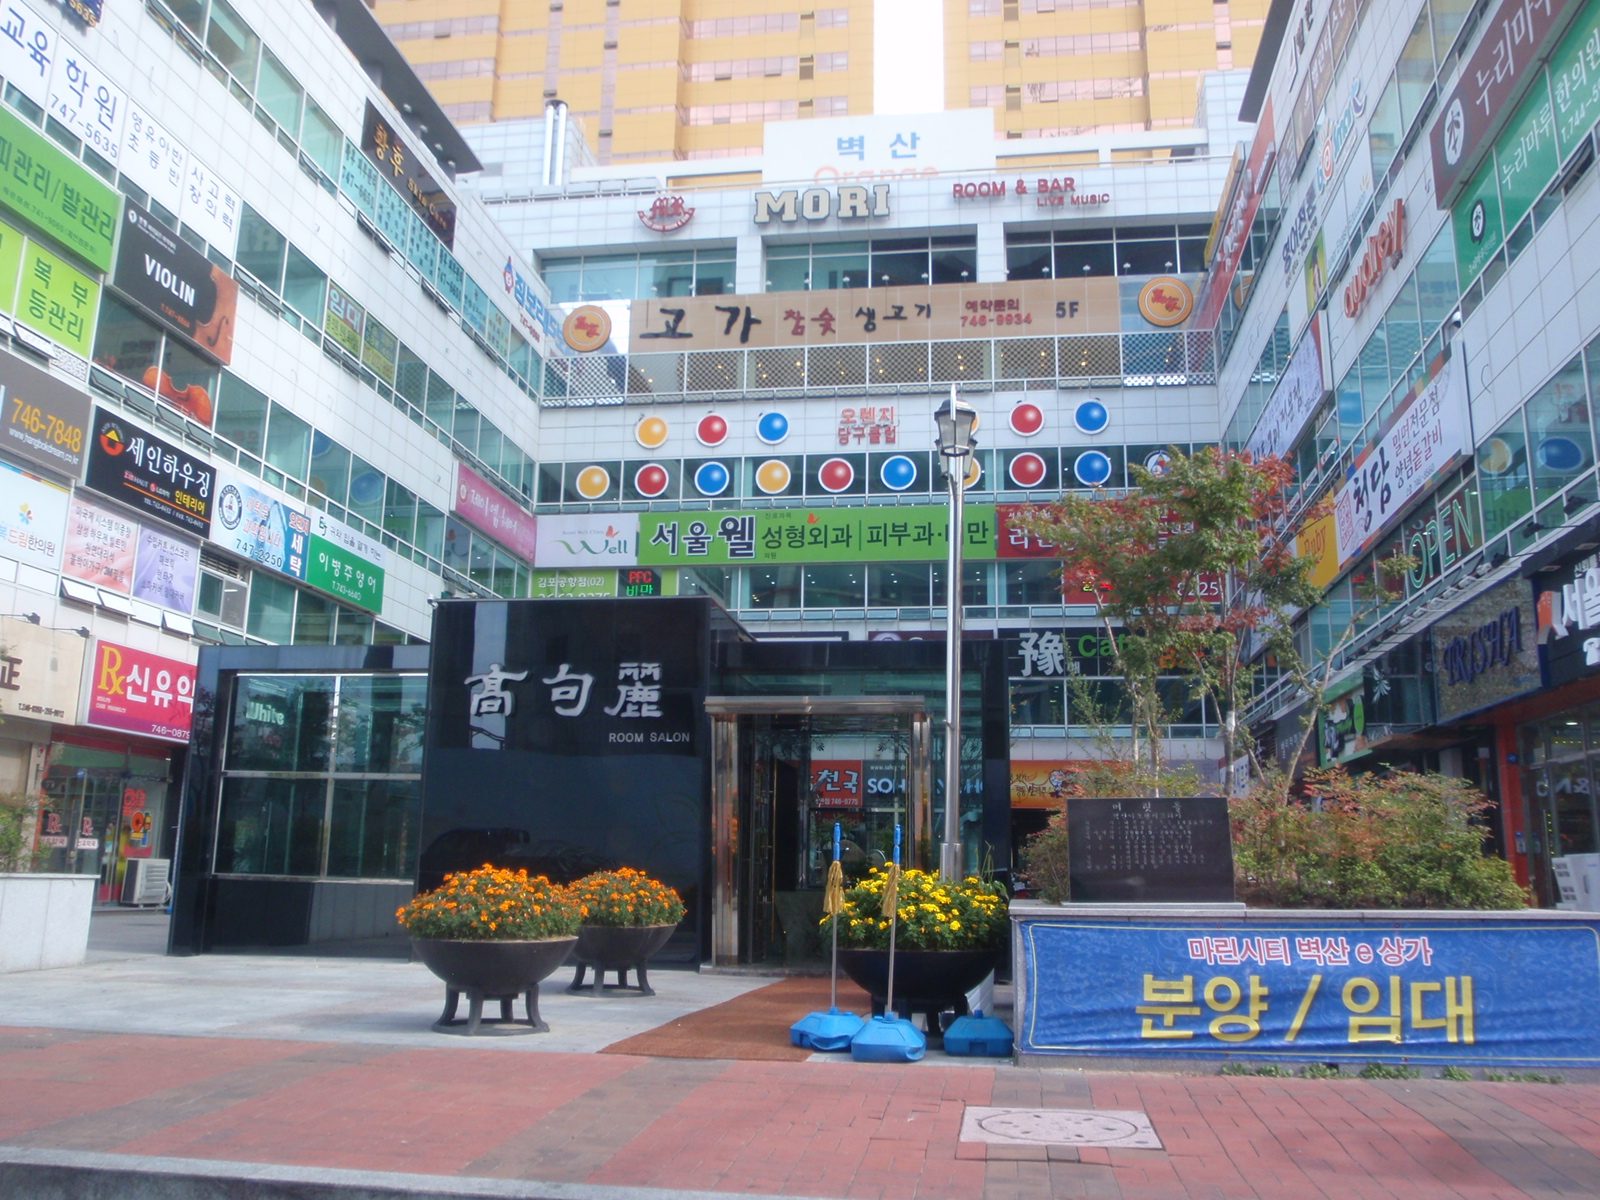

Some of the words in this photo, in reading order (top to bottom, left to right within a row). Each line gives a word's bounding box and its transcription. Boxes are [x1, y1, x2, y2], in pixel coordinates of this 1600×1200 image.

[0, 7, 51, 78] 교육
[66, 58, 118, 134] 학원
[1476, 0, 1551, 117] 누리마
[50, 92, 119, 159] 747-5635
[1502, 103, 1554, 191] 누리마루
[1554, 27, 1600, 114] 한의원
[836, 131, 921, 161] 벽산
[753, 184, 892, 225] MORI
[952, 180, 1007, 199] ROOM
[1014, 178, 1028, 195] &
[1036, 176, 1077, 194] BAR
[1036, 195, 1065, 208] LIVE
[1070, 193, 1111, 207] MUSIC
[143, 253, 196, 307] VIOLIN
[29, 288, 85, 343] 등관리
[639, 304, 763, 344] 고가
[854, 303, 932, 333] 생고기
[1055, 301, 1079, 319] 5F
[11, 397, 82, 454] 746-7848
[839, 405, 896, 425] 오렌지
[837, 425, 897, 447] 당구클럽
[125, 436, 211, 499] 세인하우징
[174, 489, 207, 516] 인테리어
[1352, 446, 1392, 533] 청담
[234, 537, 283, 568] 747-2250
[289, 532, 304, 577] 세탁
[555, 537, 628, 556] Well
[649, 514, 756, 560] 서울웰
[761, 518, 853, 550] 성형외과
[866, 519, 989, 549] 피부과·만
[1408, 487, 1476, 590] OPEN
[1077, 633, 1130, 658] Caf
[463, 662, 664, 718] 高句麗
[246, 701, 285, 726] White
[608, 732, 644, 744] ROOM
[649, 731, 690, 743] SALON
[1186, 936, 1290, 967] 마린시티
[1297, 937, 1350, 967] 벽산
[1356, 943, 1374, 965] e
[1377, 937, 1434, 966] 상가
[1134, 973, 1270, 1042] 분양
[1283, 974, 1323, 1042] /
[1341, 975, 1476, 1045] 임대
